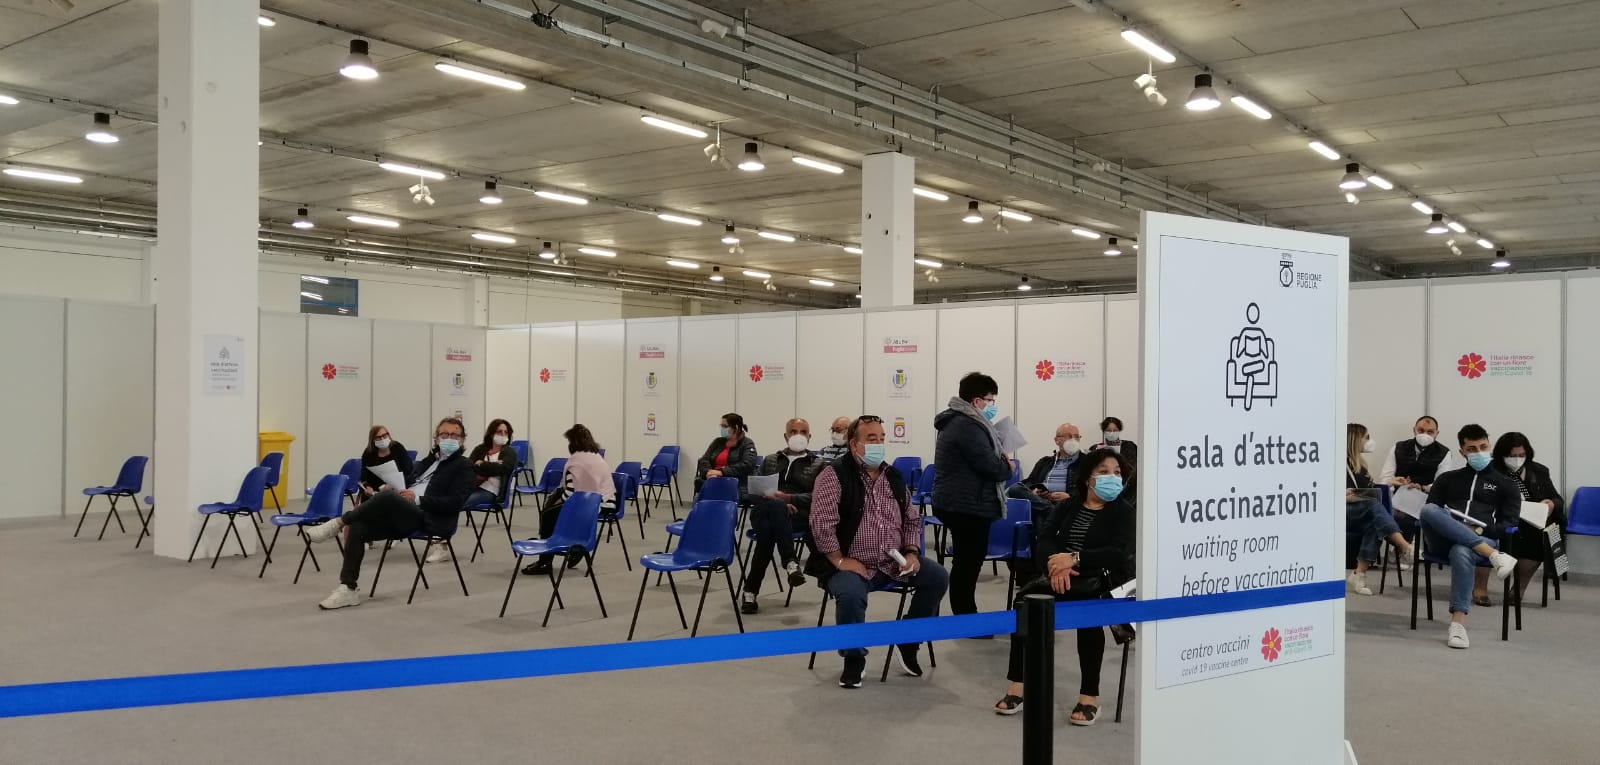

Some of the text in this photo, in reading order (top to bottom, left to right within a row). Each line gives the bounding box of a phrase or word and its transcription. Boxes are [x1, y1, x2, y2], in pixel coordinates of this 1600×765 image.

[1296, 272, 1322, 281] REGIONE
[1296, 280, 1318, 289] PUGLIA
[1177, 431, 1320, 469] sala d'attesa
[1176, 481, 1317, 523] vaccinazioni
[1182, 534, 1279, 562] waiting room
[1182, 562, 1315, 597] before vaccination
[1181, 635, 1251, 661] centro vaccini
[1181, 665, 1198, 677] covid
[1199, 662, 1207, 673] 19
